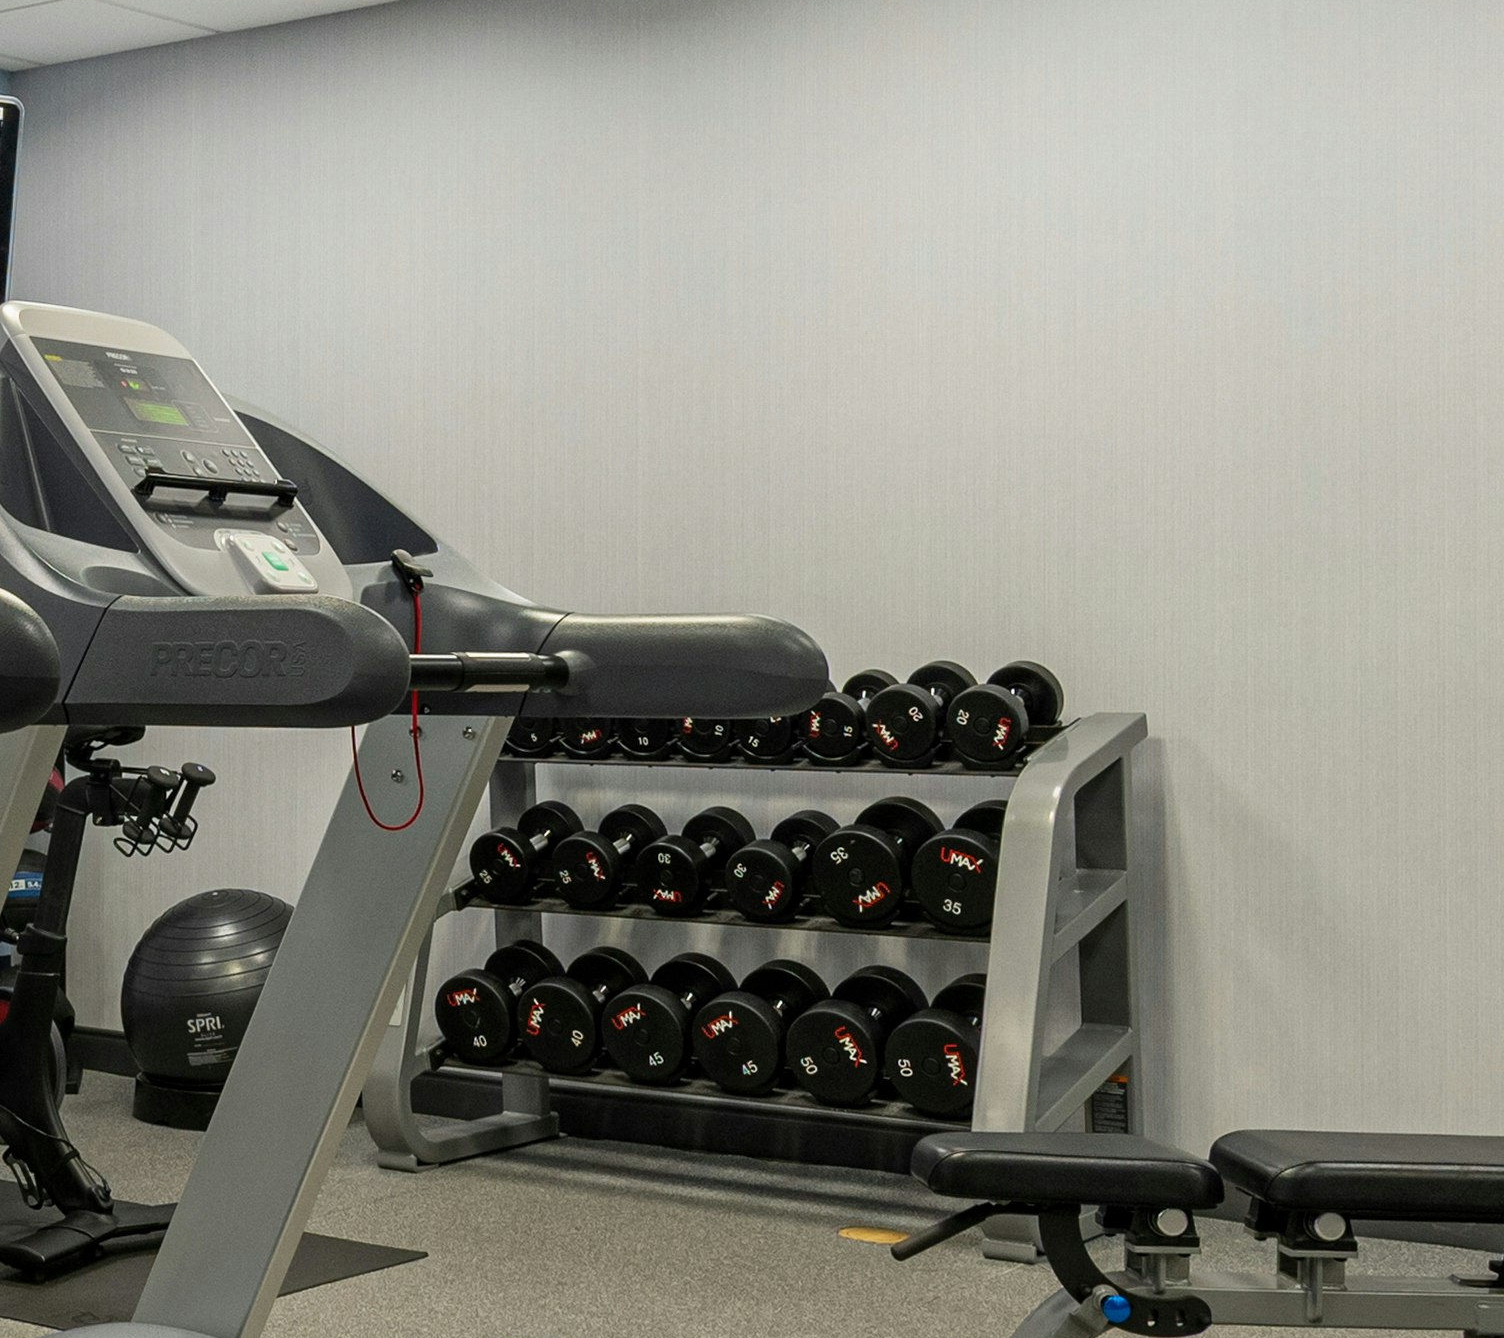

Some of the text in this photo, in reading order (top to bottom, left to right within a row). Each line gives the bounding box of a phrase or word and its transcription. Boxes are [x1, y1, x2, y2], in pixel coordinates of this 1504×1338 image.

[150, 639, 288, 678] PRECOR
[908, 705, 924, 722] 20
[956, 709, 970, 725] 20
[714, 724, 724, 736] 10
[843, 724, 854, 738] 15
[872, 718, 899, 751] UMAX
[992, 717, 1011, 750] UMAX
[638, 737, 649, 746] 10
[747, 735, 760, 748] 15
[497, 843, 521, 869] UMAX
[657, 852, 672, 864] 30
[830, 846, 849, 864] 35
[941, 847, 984, 874] UMAX
[586, 851, 605, 881] UMAX
[733, 863, 747, 878] 30
[479, 869, 492, 884] 25
[559, 869, 571, 884] 25
[653, 888, 682, 903] UMAX
[762, 880, 785, 910] UMAX
[851, 881, 890, 913] UMAX
[942, 898, 962, 916] 35
[446, 988, 480, 1007] UMAX
[526, 998, 546, 1036] UMAX
[611, 1002, 647, 1030] UMAX
[701, 1011, 738, 1039] UMAX
[473, 1034, 488, 1048] 40
[570, 1029, 585, 1047] 40
[834, 1026, 867, 1068] UMAX
[648, 1051, 665, 1067] 45
[742, 1060, 758, 1076] 45
[800, 1056, 818, 1075] 50
[897, 1058, 913, 1077] 50
[943, 1044, 968, 1086] UMAX
